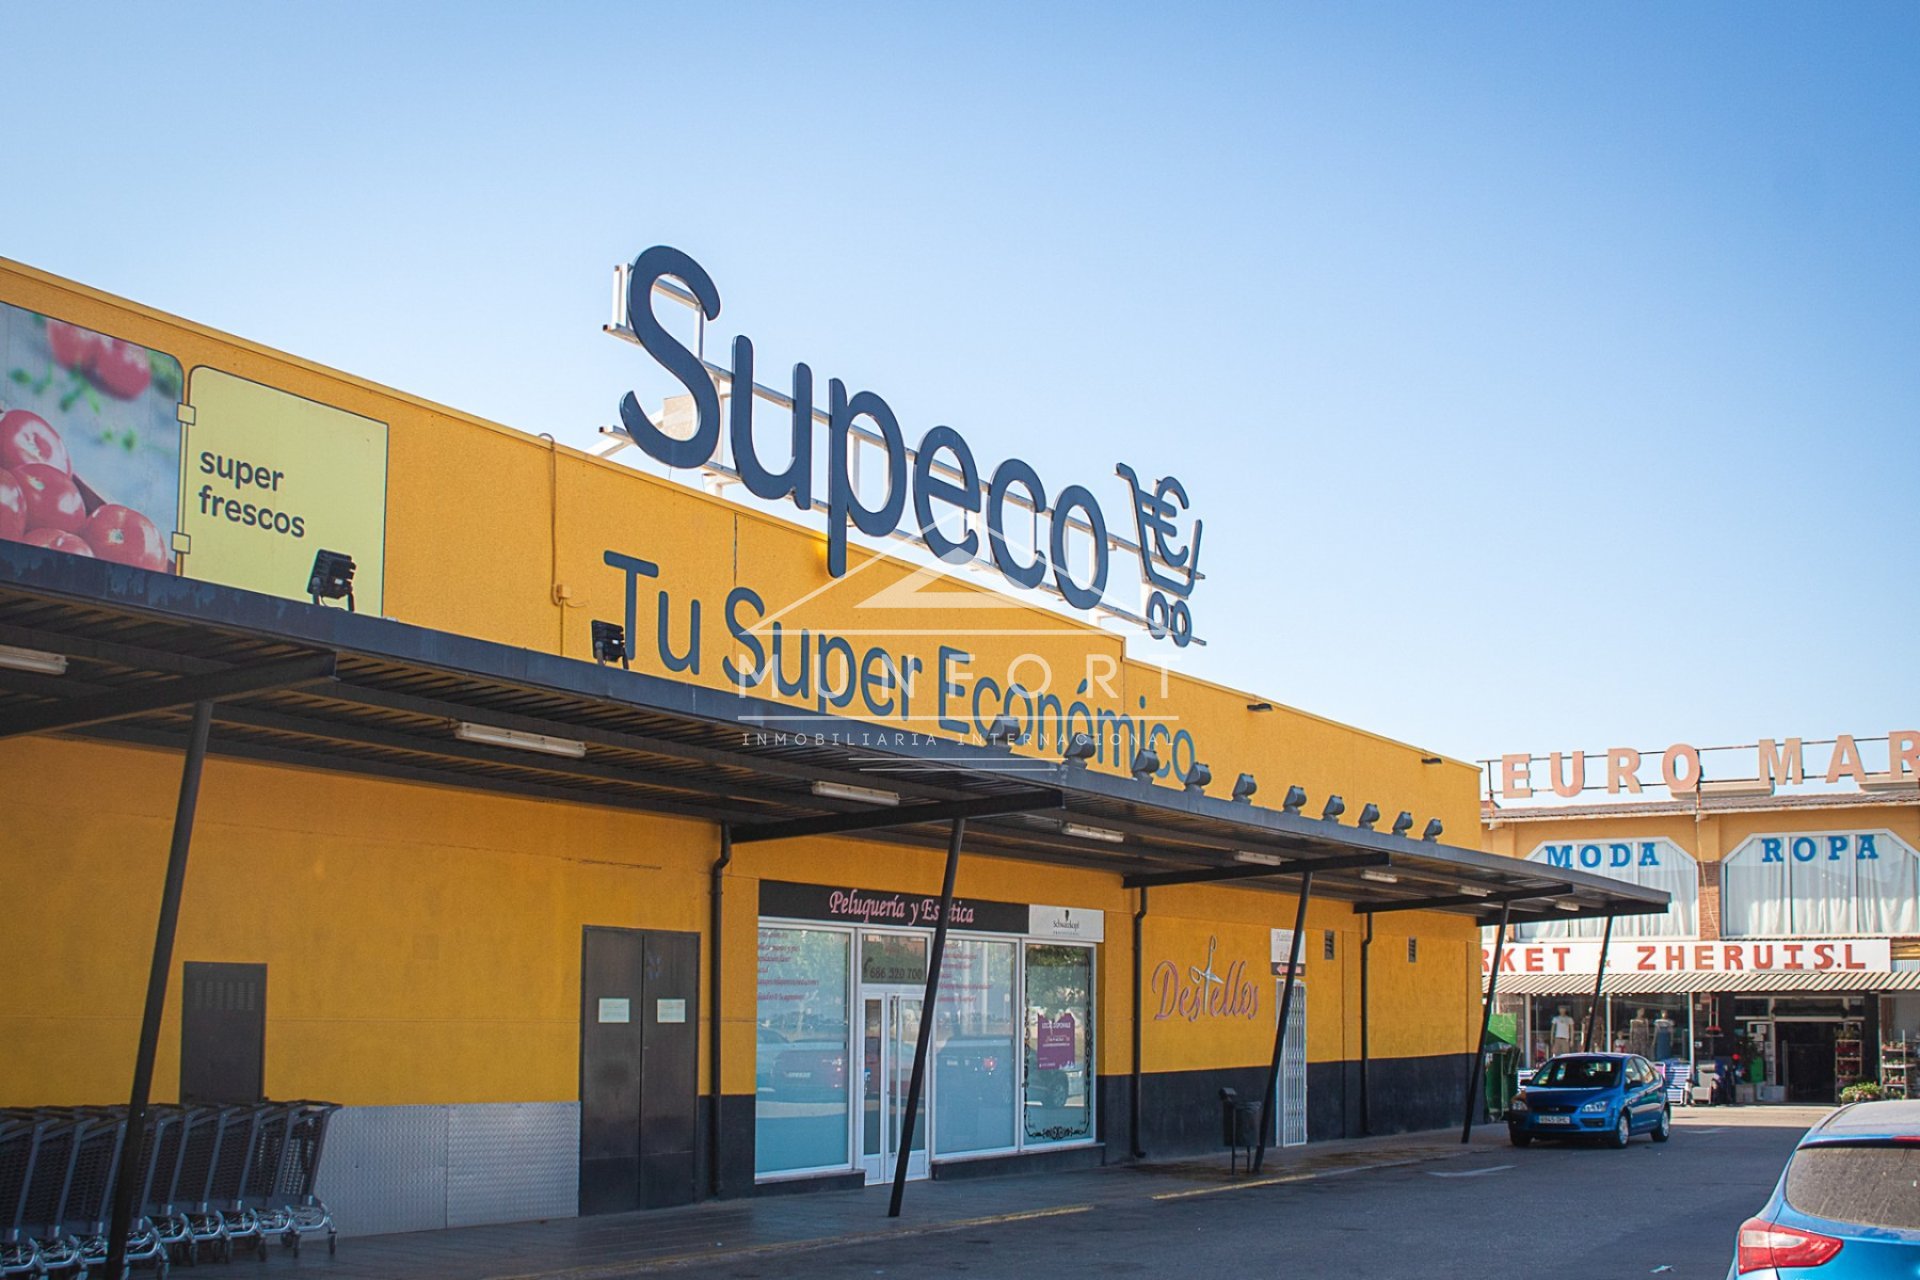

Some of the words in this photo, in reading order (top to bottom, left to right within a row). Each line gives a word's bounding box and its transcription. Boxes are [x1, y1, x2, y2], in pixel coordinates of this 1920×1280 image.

[620, 245, 1109, 609] Supeco
[200, 451, 284, 491] super
[198, 486, 305, 538] frescos
[604, 550, 701, 675] Tu
[722, 587, 923, 721] Super
[938, 645, 1196, 784] Económico
[1502, 743, 1701, 799] EURO
[1758, 730, 1920, 786] MAR
[1545, 842, 1660, 870] MODA
[1761, 834, 1879, 863] ROPA
[829, 889, 905, 924] Peluquería
[908, 902, 919, 926] y
[921, 898, 974, 923] Estica
[1151, 935, 1259, 1022] Destellos
